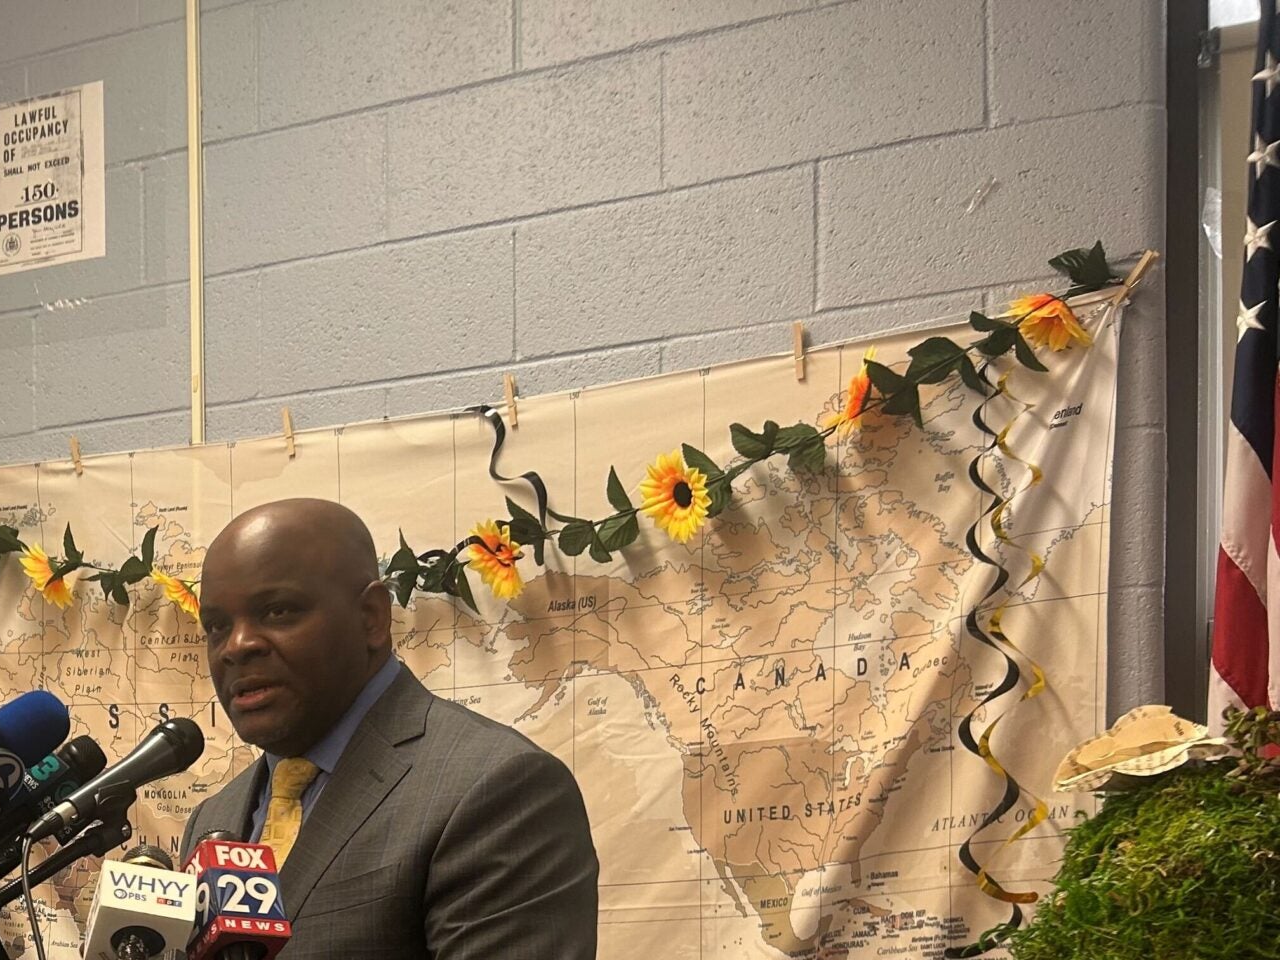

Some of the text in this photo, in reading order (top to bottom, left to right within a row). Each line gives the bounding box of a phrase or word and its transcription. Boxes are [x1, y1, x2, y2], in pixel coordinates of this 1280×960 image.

[14, 106, 57, 127] LAWFUL
[4, 119, 68, 146] OCCUPANCY
[3, 148, 16, 163] OF
[4, 156, 70, 177] SHALL NOT EXCEED
[547, 595, 596, 613] Alaska (US)
[184, 634, 207, 644] Sibe
[848, 632, 872, 641] Hudson
[75, 648, 100, 657] West
[853, 643, 866, 653] Bay
[66, 666, 110, 678] Siberian
[696, 652, 910, 695] CANADA
[75, 684, 102, 693] Plain
[587, 697, 607, 706] Gulf of
[669, 673, 738, 796] Rocky Mountains
[31, 755, 60, 780] 3
[144, 790, 187, 799] MONGOLIA
[157, 803, 192, 813] Gobi Dese
[723, 792, 862, 824] UNITED STATES
[931, 805, 1069, 832] ATLANTC OCAN
[185, 851, 203, 875] OX
[214, 845, 269, 870] FOX
[870, 871, 898, 880] Bahamas
[110, 870, 189, 897] WHYY
[129, 892, 147, 901] PBS
[217, 873, 278, 914] 29
[801, 885, 842, 897] Gulf of Mexico
[196, 882, 210, 927] 9
[760, 897, 788, 909] MEXICO
[853, 906, 870, 915] CUBA
[224, 919, 286, 932] NEWS
[852, 929, 878, 938] JAMAICA
[832, 940, 864, 949] HONDURAS
[908, 944, 918, 952] Sea
